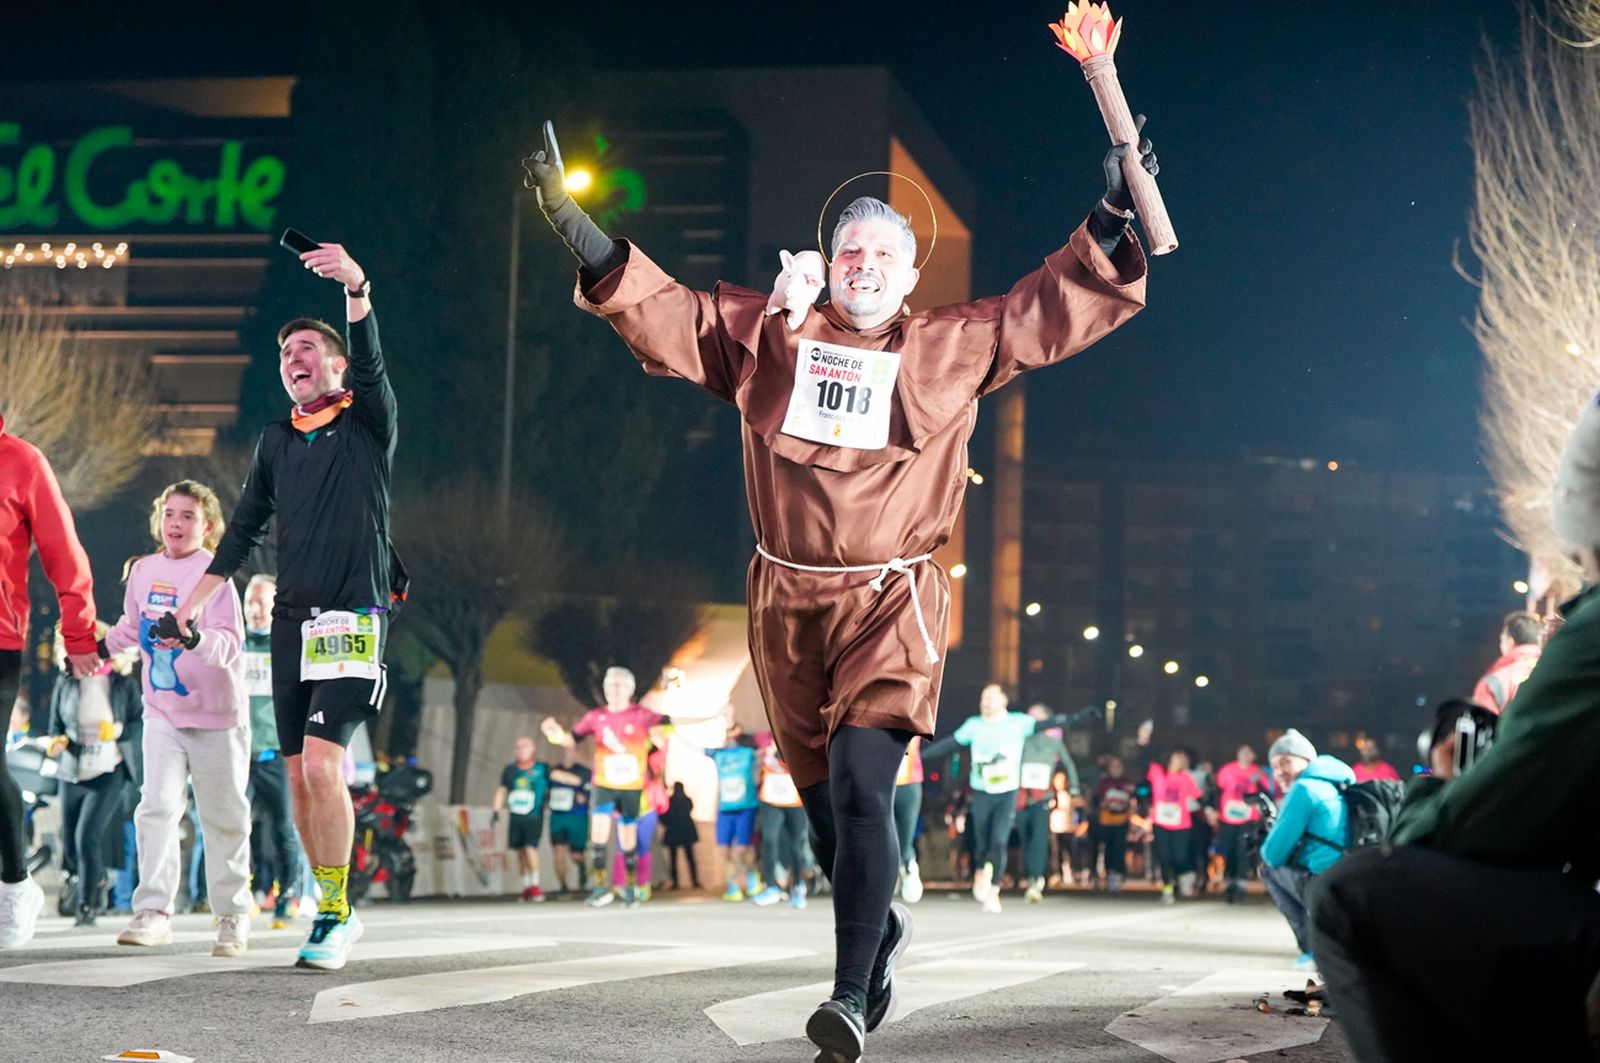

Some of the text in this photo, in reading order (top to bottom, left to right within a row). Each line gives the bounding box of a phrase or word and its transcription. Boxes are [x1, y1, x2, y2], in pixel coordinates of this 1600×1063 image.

[65, 125, 286, 229] Corte
[809, 363, 828, 377] SAN
[821, 354, 850, 369] NOCHE
[851, 360, 864, 370] DE
[817, 379, 872, 415] 1018
[309, 629, 323, 638] SAN
[315, 634, 366, 656] 4965
